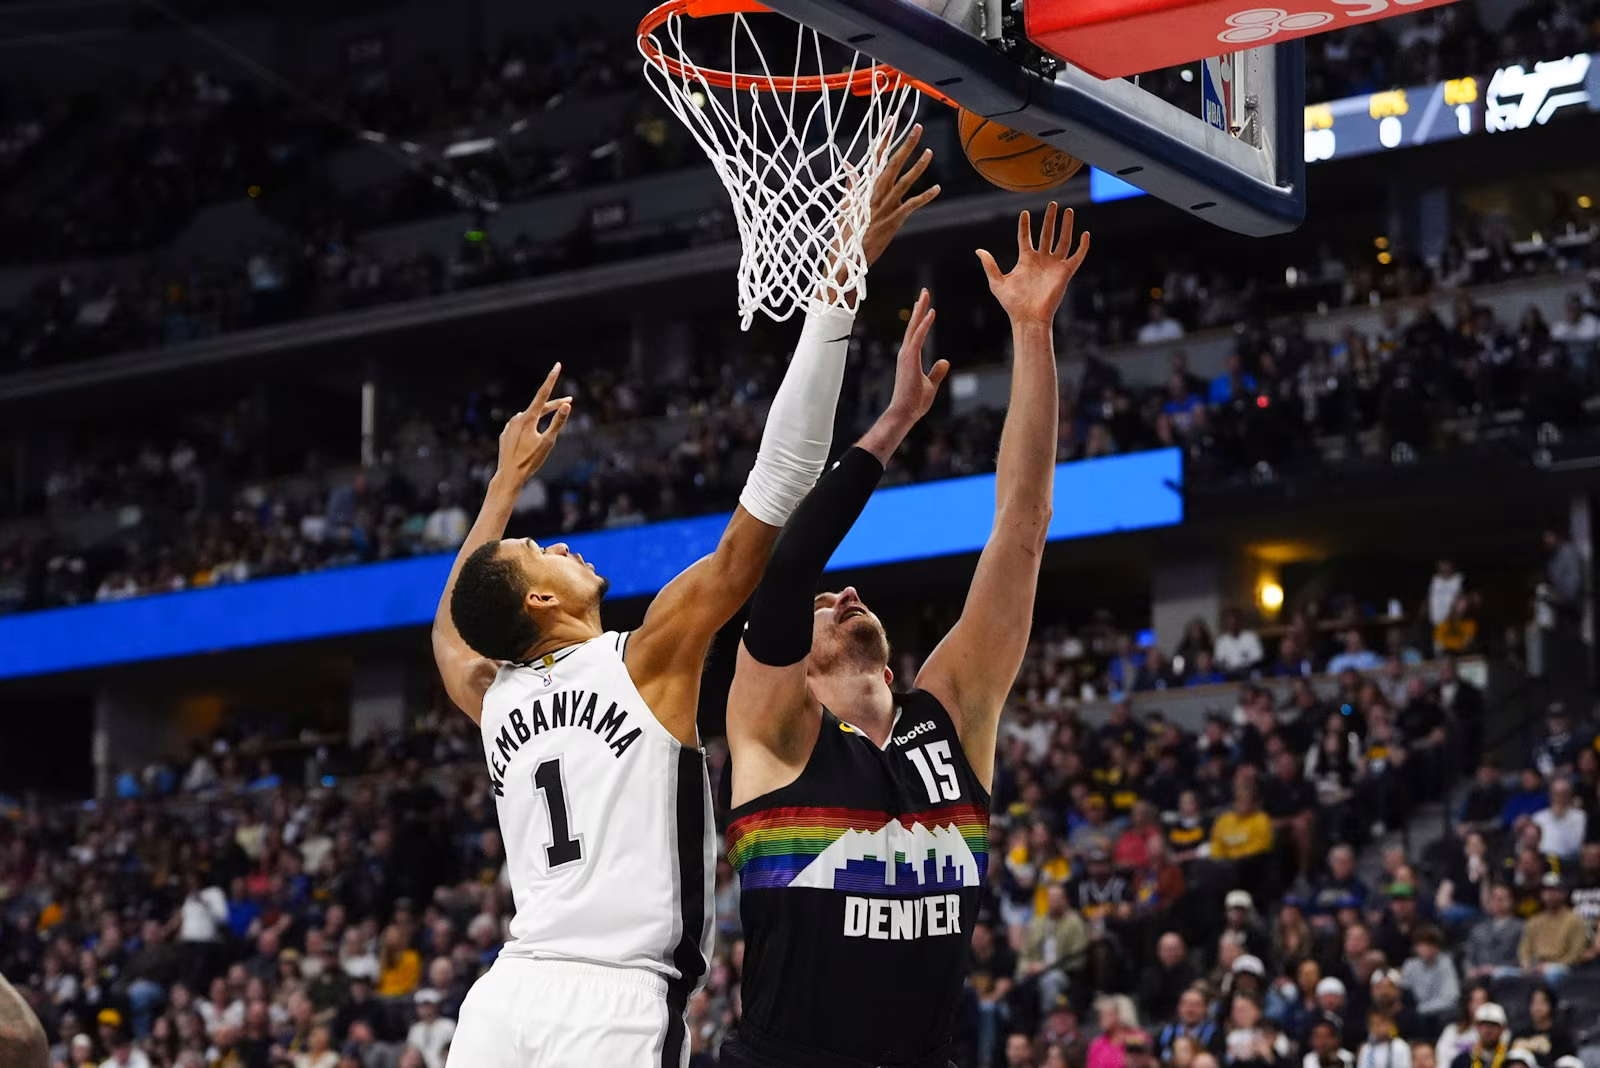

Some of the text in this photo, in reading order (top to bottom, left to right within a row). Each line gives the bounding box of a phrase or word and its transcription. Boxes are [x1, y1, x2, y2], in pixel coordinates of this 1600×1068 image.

[1205, 98, 1224, 130] NBA
[491, 690, 642, 798] WEMBANYAMA
[904, 739, 961, 804] 15
[532, 755, 584, 871] 1
[843, 894, 961, 940] DENVER
